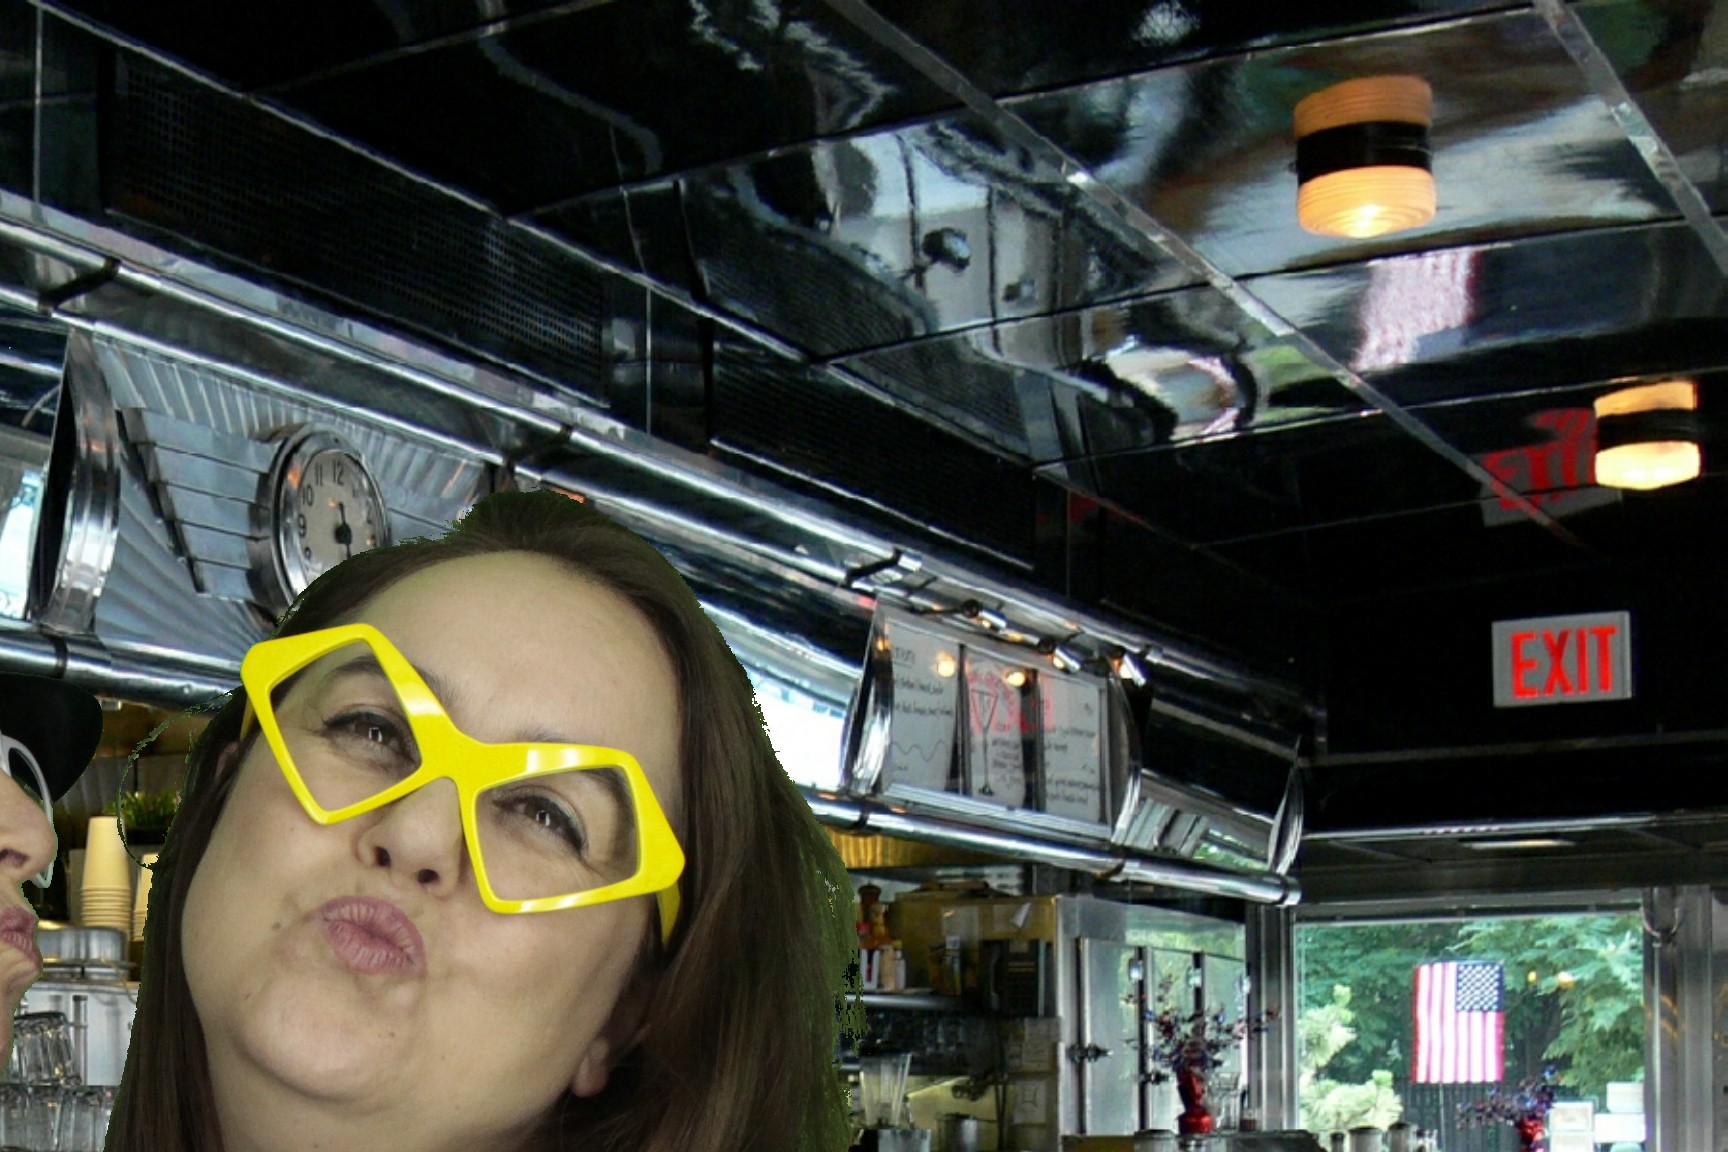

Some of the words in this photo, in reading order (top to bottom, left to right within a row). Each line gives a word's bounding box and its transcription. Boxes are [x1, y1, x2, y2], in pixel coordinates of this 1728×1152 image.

[333, 459, 344, 486] 12
[302, 484, 314, 507] 10
[297, 514, 306, 538] 9
[1509, 625, 1618, 698] EXIT
